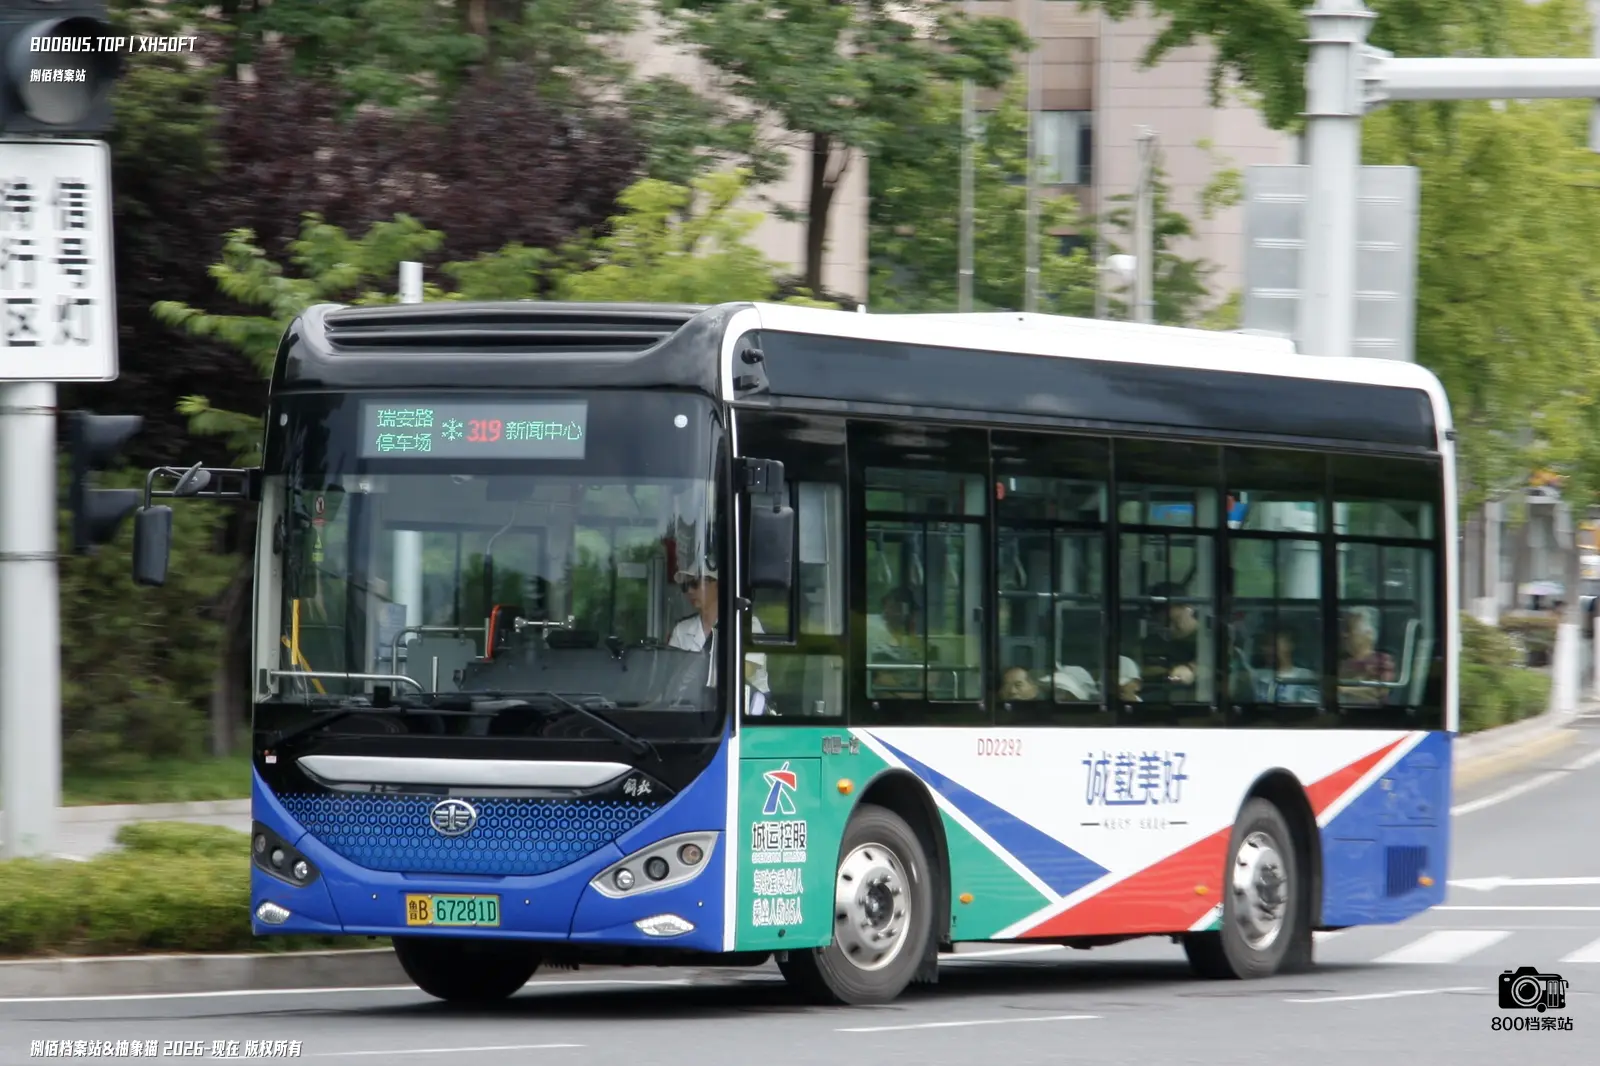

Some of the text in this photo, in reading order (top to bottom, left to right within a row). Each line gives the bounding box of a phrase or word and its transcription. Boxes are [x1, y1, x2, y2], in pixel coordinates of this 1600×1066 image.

[377, 408, 434, 428] 瑞安路
[467, 419, 502, 442] 319
[506, 421, 582, 440] 新闻中心
[376, 433, 432, 452] 停车场
[977, 738, 1022, 756] DD2292
[1081, 750, 1189, 806] 诚载美好
[753, 821, 806, 850] 城运控股
[436, 900, 497, 922] 67281D
